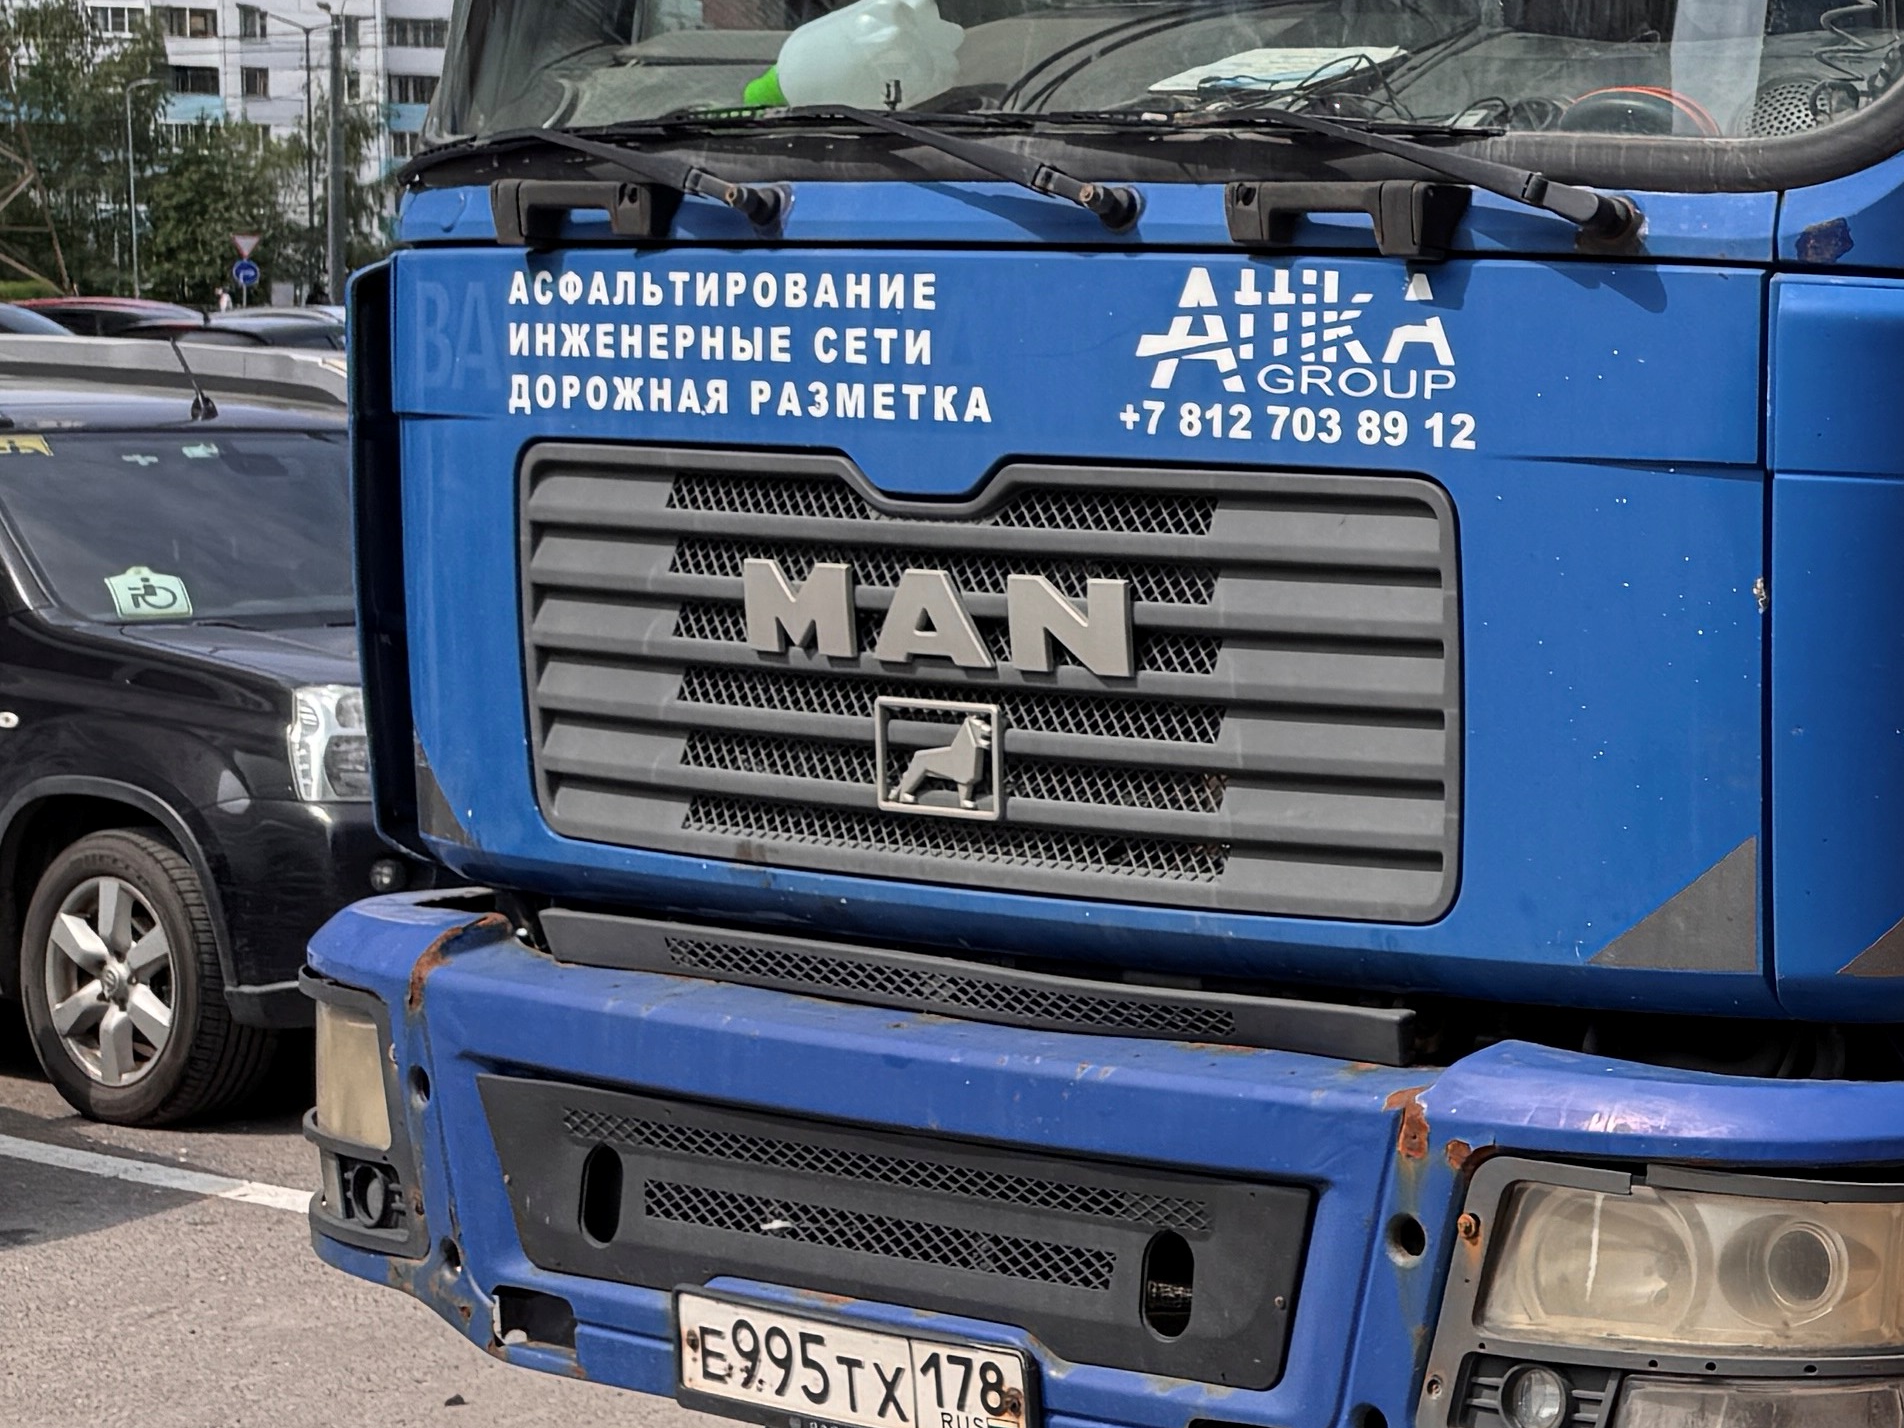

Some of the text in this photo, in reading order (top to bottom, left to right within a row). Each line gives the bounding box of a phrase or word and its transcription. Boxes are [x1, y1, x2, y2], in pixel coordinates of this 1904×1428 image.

[508, 270, 936, 310] АСФАЛЬТИРОВАНИЕ
[508, 322, 931, 365] ИНЖЕНЕРНЫЕ СЕТИ
[508, 374, 992, 423] ДОРОЖНАЯ РАЗМЕТКА
[1257, 363, 1456, 400] GROUP
[1119, 399, 1477, 450] +7 812 703 89 12
[743, 557, 1135, 677] MAN
[920, 1352, 1007, 1417] 178
